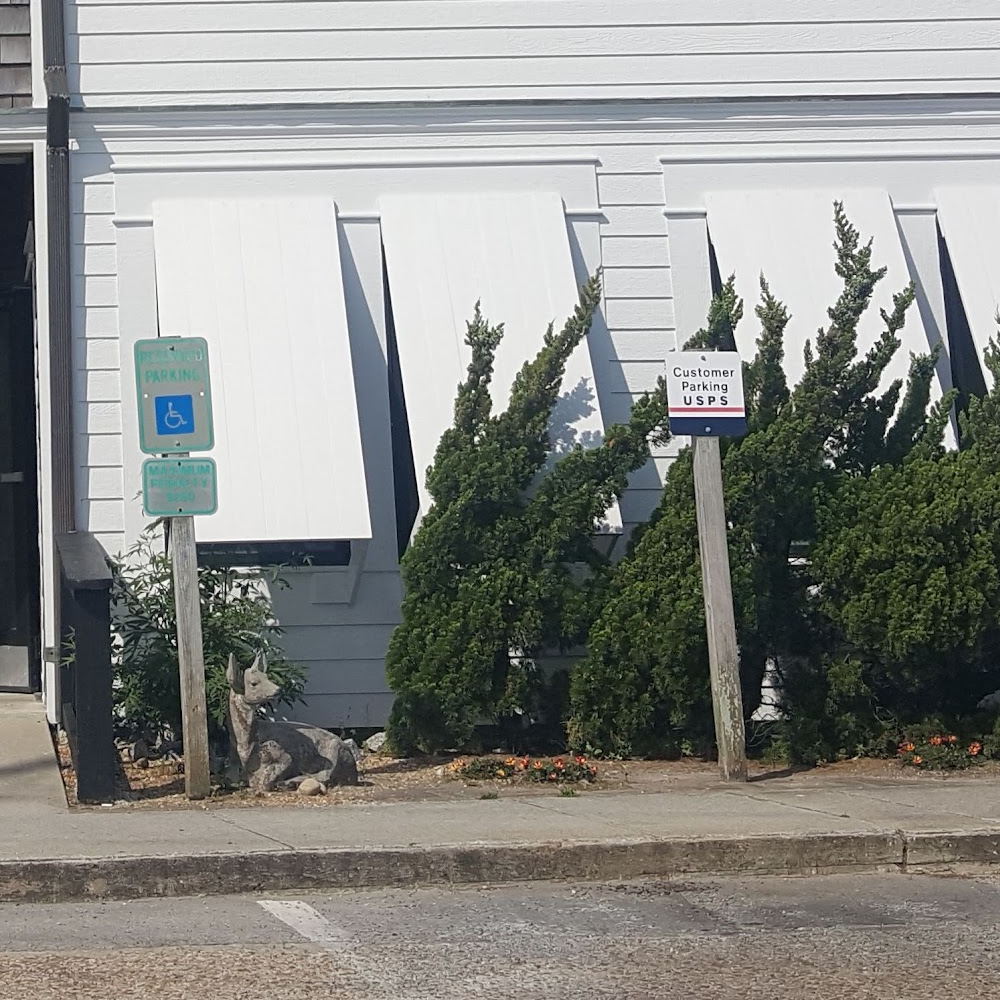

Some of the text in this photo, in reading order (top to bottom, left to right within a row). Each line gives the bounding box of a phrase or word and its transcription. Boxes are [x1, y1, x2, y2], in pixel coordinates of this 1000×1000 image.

[145, 368, 200, 383] PARKING
[673, 366, 735, 378] Customer
[681, 381, 728, 394] Parking
[683, 395, 728, 406] USPS
